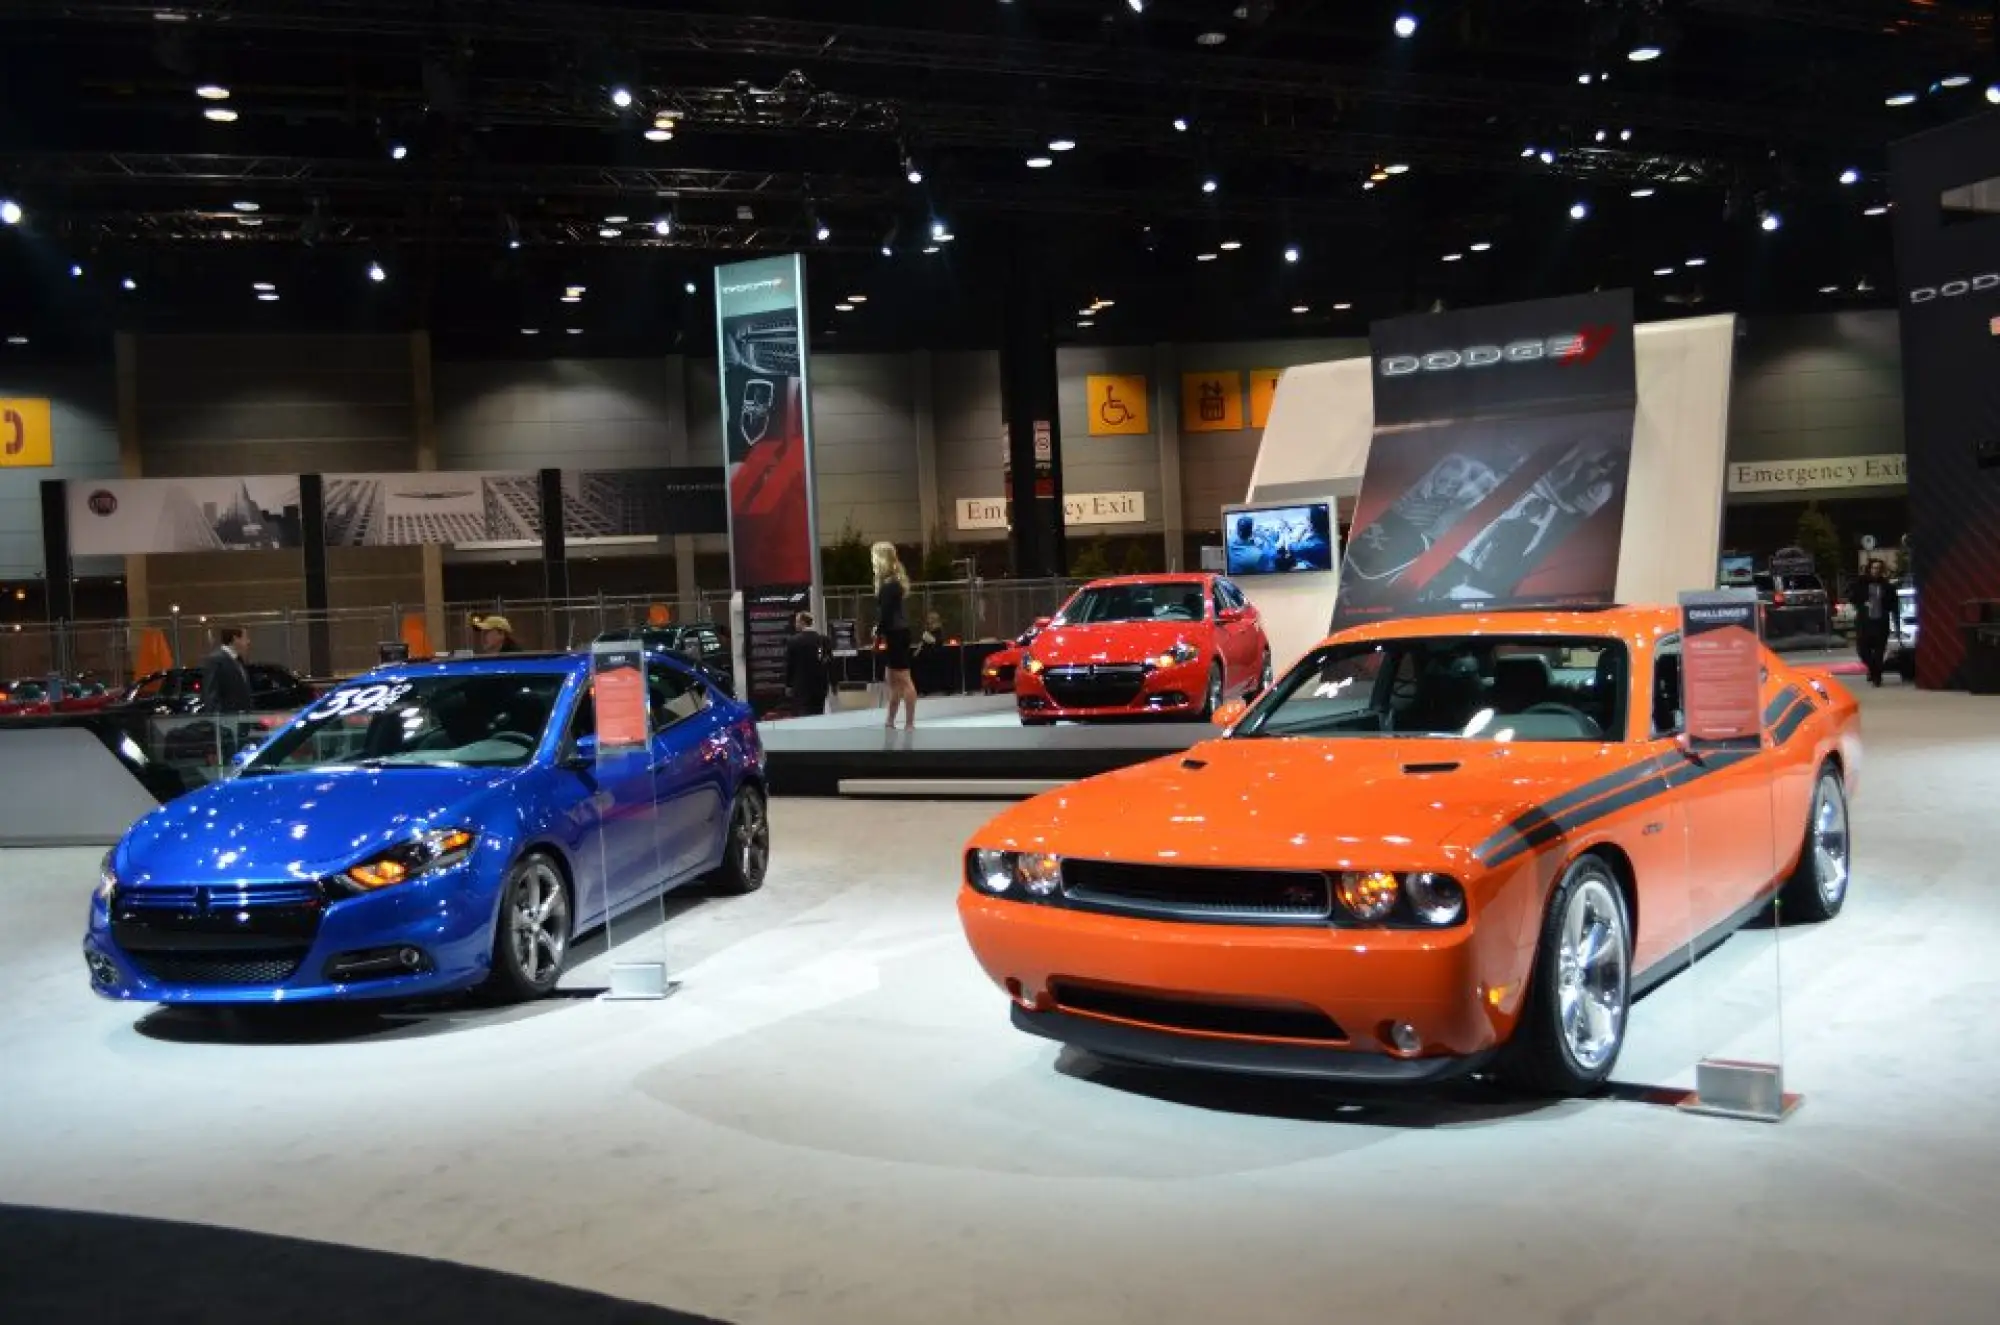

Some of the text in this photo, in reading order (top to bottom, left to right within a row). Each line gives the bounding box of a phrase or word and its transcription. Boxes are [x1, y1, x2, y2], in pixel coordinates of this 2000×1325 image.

[1381, 335, 1584, 376] DODGE
[1738, 456, 1908, 486] Emergency Exit
[1092, 496, 1134, 515] Exit
